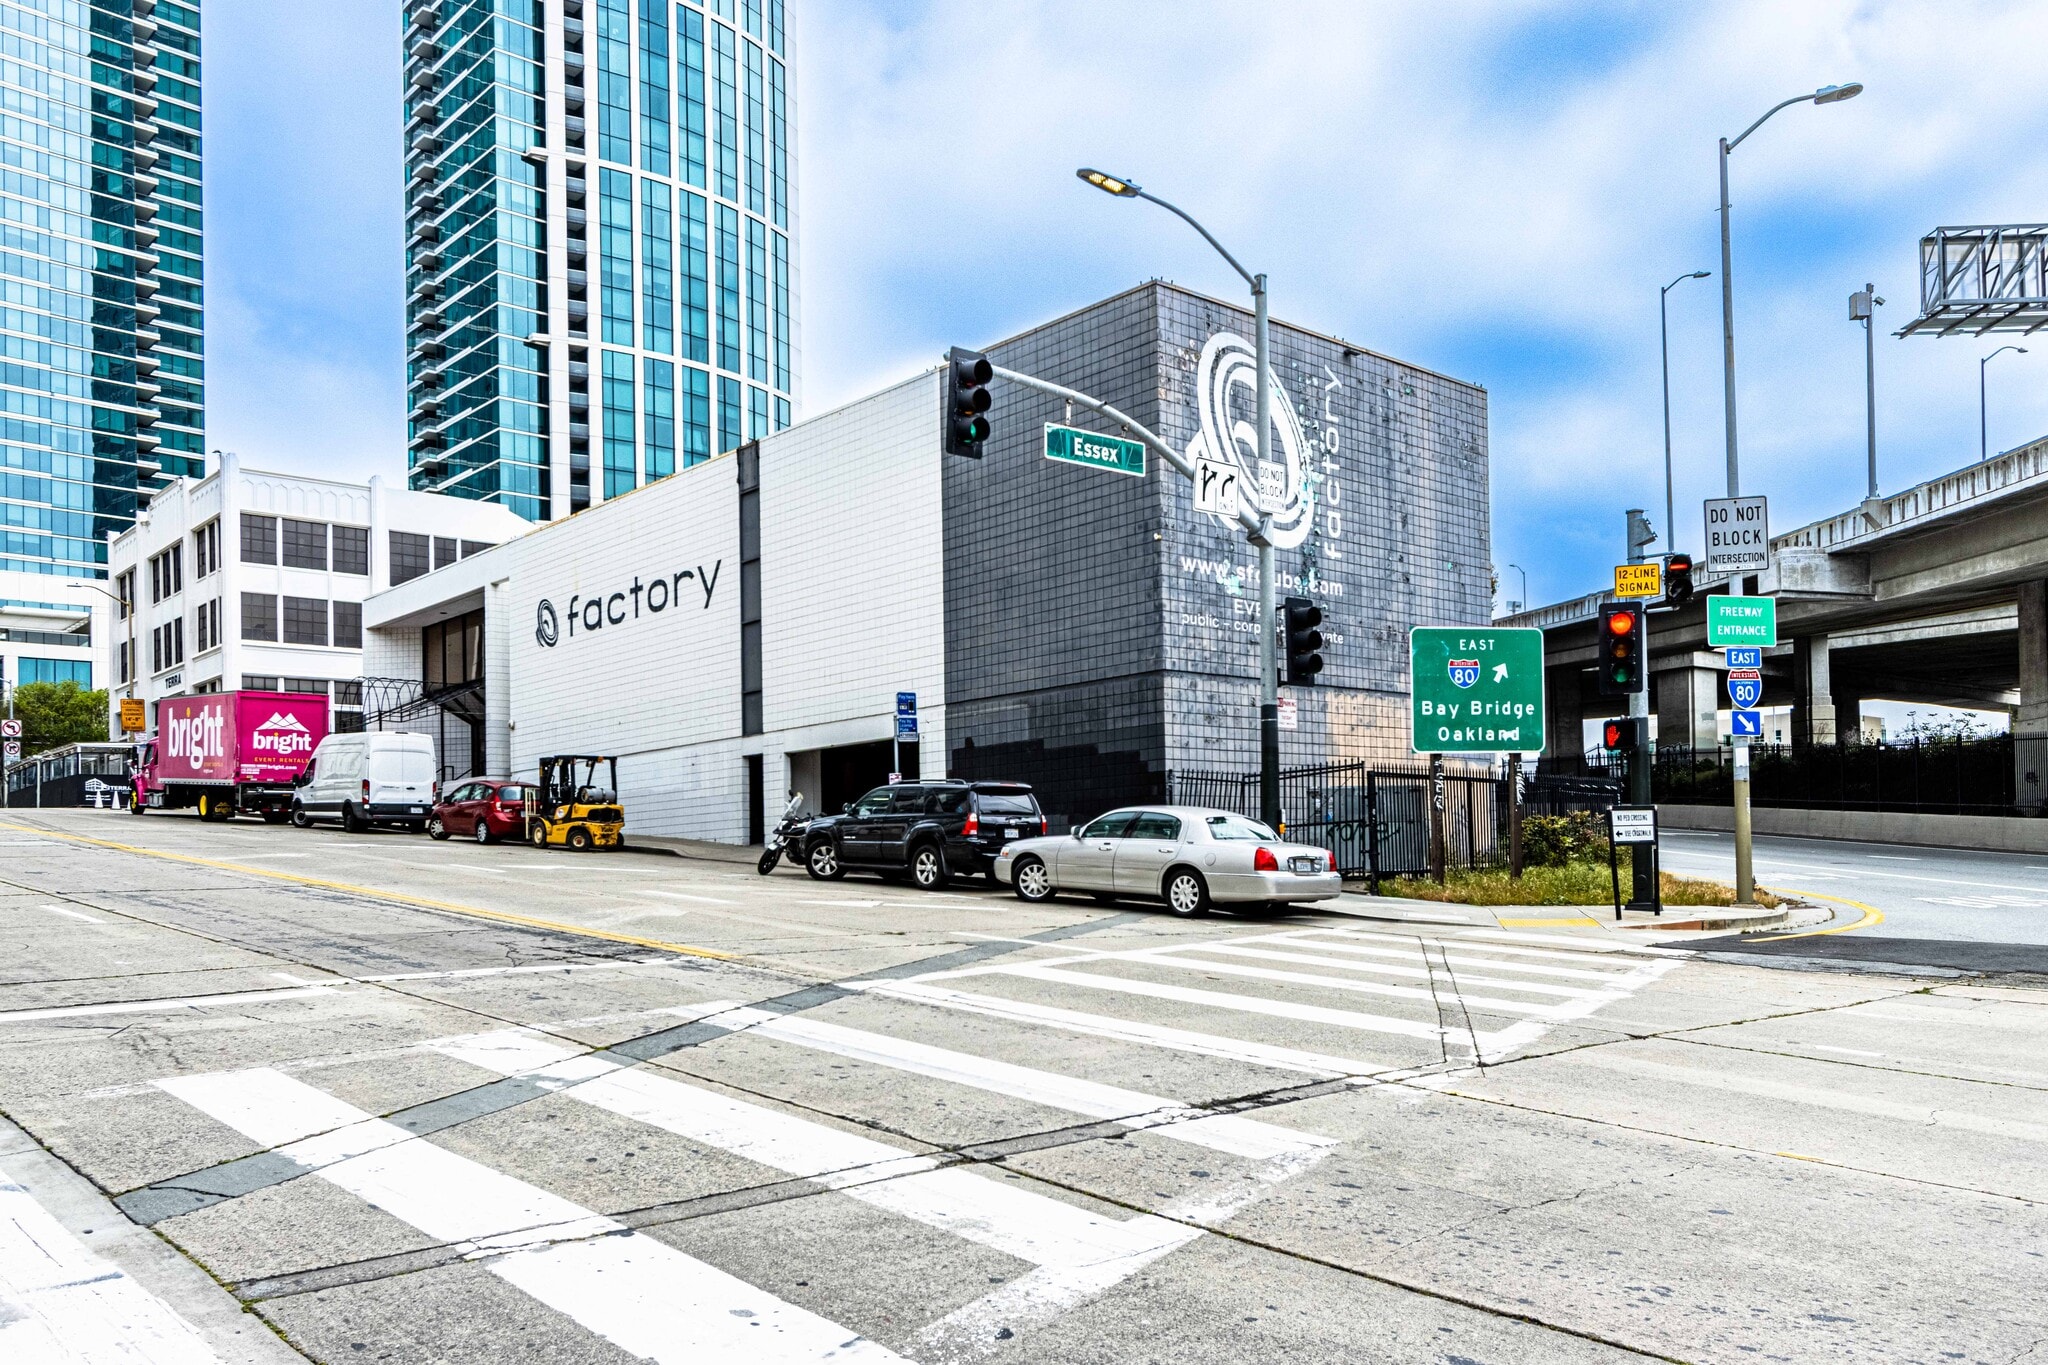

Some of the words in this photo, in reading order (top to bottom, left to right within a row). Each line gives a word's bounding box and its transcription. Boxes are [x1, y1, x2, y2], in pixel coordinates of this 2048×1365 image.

[1074, 437, 1119, 463] Essex
[1321, 364, 1342, 560] factory
[1260, 467, 1269, 479] DO
[1271, 470, 1283, 482] NOT
[1260, 483, 1284, 499] BLOCK
[1710, 508, 1728, 524] DO
[1736, 505, 1762, 521] NOT
[1712, 529, 1762, 547] BLOCK
[1710, 551, 1766, 565] INTERSECTION
[1618, 568, 1656, 580] 12-LINE
[1619, 582, 1656, 593] SIGNAL
[567, 559, 722, 637] factory
[1181, 612, 1220, 628] public
[1720, 606, 1764, 618] FREEWAY
[1717, 625, 1768, 636] ENTRANCE
[1459, 639, 1496, 651] EAST
[1731, 651, 1756, 664] EAST
[165, 673, 181, 690] TERRA
[1454, 669, 1475, 684] 80
[1736, 685, 1754, 701] 80
[1421, 700, 1460, 720] Bay
[1470, 700, 1535, 720] Bridge
[168, 705, 224, 770] bright
[1438, 726, 1520, 742] Oakland
[253, 731, 312, 754] bright
